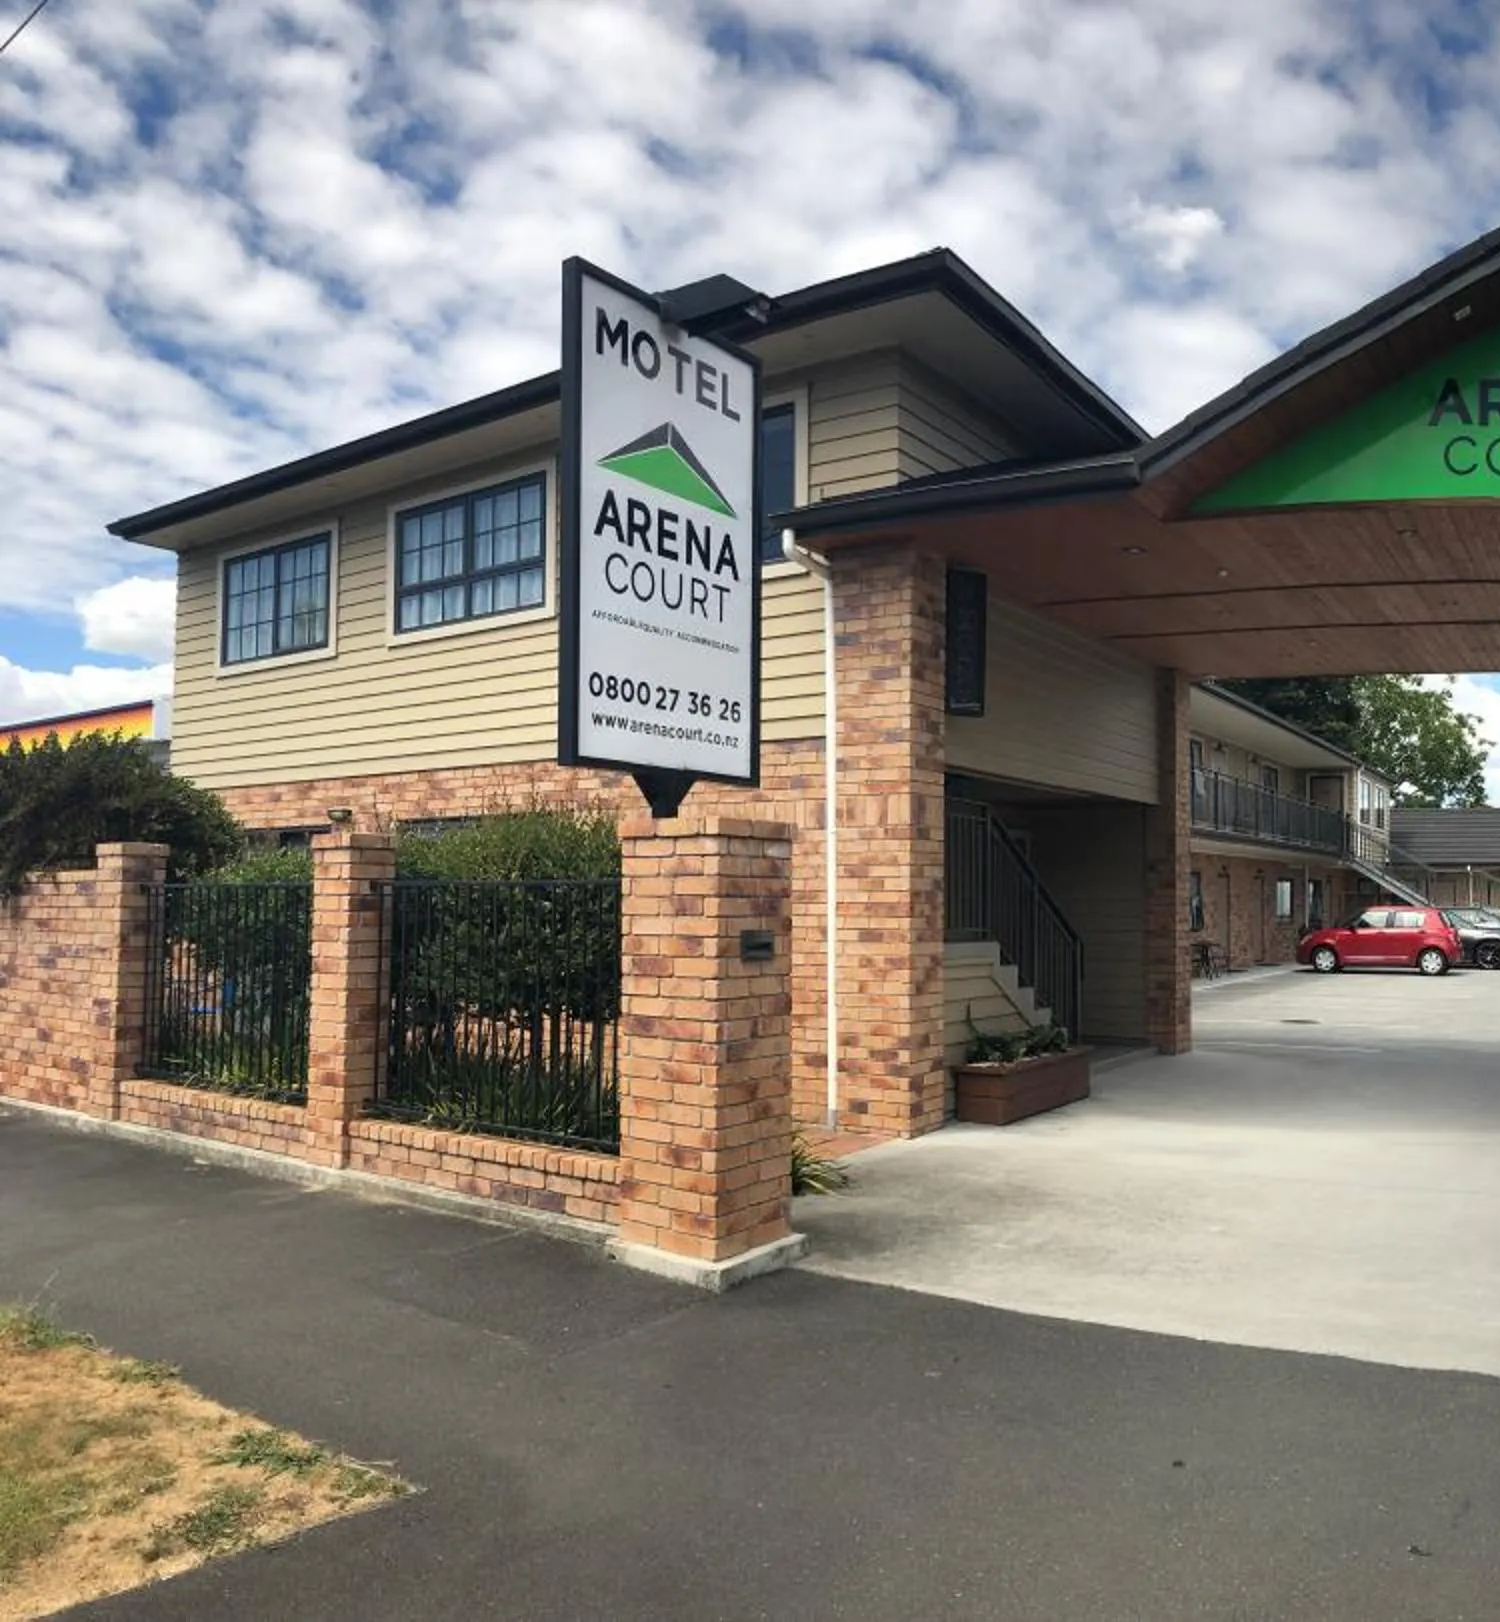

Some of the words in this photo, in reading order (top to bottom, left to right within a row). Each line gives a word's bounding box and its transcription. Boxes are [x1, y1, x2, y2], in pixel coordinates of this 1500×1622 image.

[596, 306, 741, 423] MOTEL
[594, 488, 740, 582] ARENA
[605, 552, 731, 623] COURT
[589, 671, 651, 706] 0800
[655, 686, 680, 712] 27
[687, 691, 711, 717] 36
[719, 698, 741, 723] 26
[592, 712, 739, 749] www.arenacourt.co.nz
